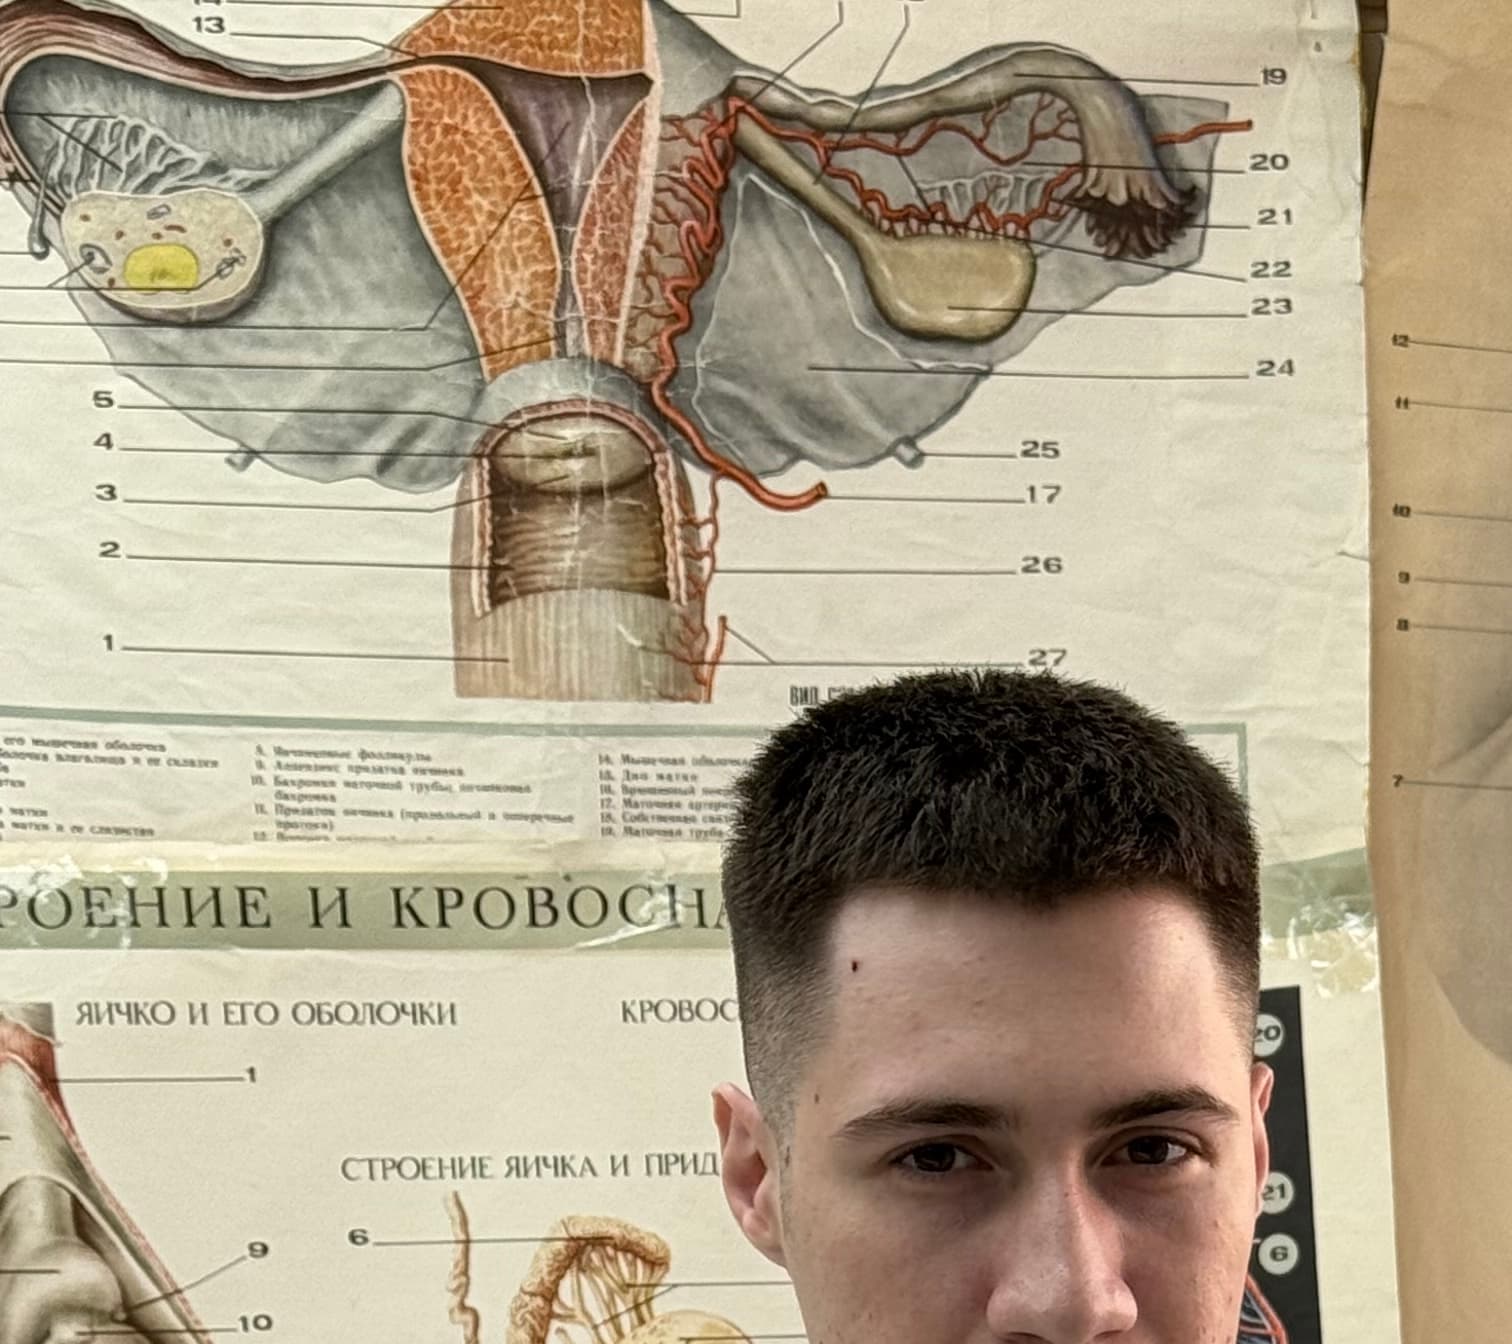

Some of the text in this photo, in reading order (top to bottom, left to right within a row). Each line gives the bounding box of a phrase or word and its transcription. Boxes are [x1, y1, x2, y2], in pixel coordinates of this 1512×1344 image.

[192, 16, 226, 34] 13
[1261, 67, 1288, 87] 19
[1249, 153, 1290, 172] 20
[1257, 208, 1294, 227] 21
[1250, 261, 1292, 280] 22
[1251, 298, 1293, 317] 23
[1256, 359, 1296, 379] 24
[92, 391, 115, 409] 5
[93, 432, 114, 450] 4
[1020, 441, 1061, 460] 25
[95, 484, 117, 502] 3
[1026, 485, 1062, 505] 17
[99, 542, 120, 559] 2
[1020, 556, 1063, 574] 26
[102, 635, 115, 652] 1
[1028, 648, 1068, 667] 27
[308, 886, 352, 929] И
[75, 1000, 458, 1026] ЯИЧКО И ЕГО ОБОЛОЧКИ
[245, 1065, 257, 1084] 1
[341, 1154, 493, 1181] СТРОЕНИЕ
[503, 1153, 599, 1179] ЯИЧКА
[610, 1153, 631, 1178] И
[348, 1228, 371, 1248] 6
[247, 1240, 269, 1260] 9
[1269, 1246, 1288, 1262] 6
[238, 1312, 274, 1334] 10
